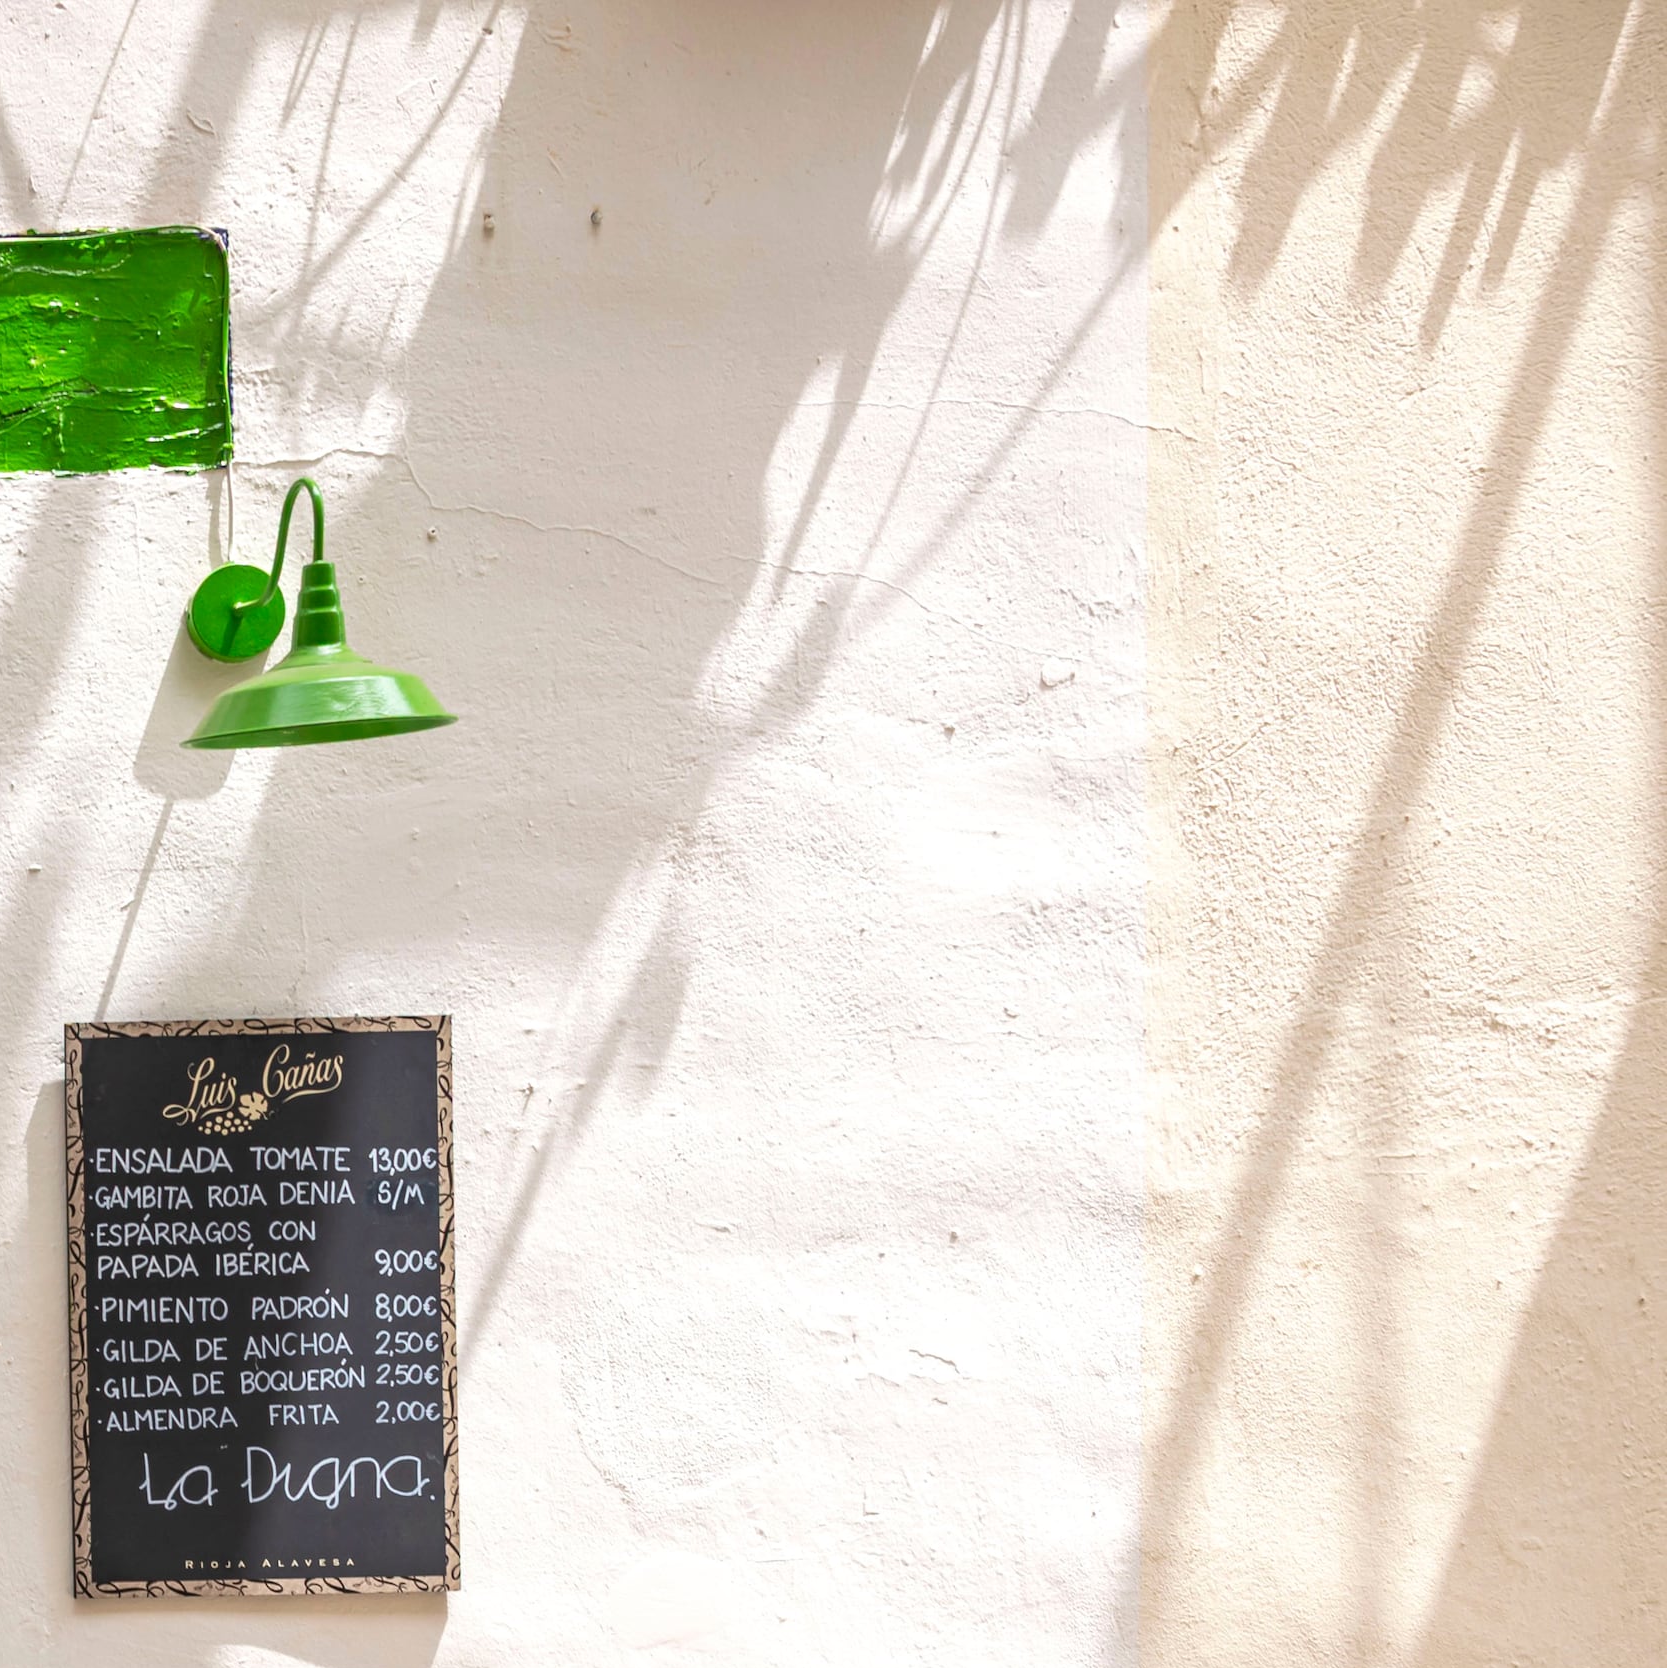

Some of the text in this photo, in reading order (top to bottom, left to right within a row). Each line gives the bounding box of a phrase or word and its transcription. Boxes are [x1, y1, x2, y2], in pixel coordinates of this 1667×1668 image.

[162, 1044, 344, 1128] Luis Cañas
[96, 1146, 437, 1177] ENSALADA TOMATE 13,00€
[94, 1178, 425, 1210] GAMBITA ROJA DENIA S/M
[96, 1213, 316, 1247] ESPÁRRAGOS CON
[97, 1242, 438, 1280] PAPADA IBÉRICA 9,00€
[101, 1287, 437, 1324] PIMIENTO PADRÓN 8,00€
[103, 1330, 439, 1363] GILDA DE ANCHOA 2,50€
[103, 1357, 440, 1400] GILDA DE BOQUERÓN 2,50€
[106, 1400, 441, 1432] ALMENDRA FRITA 2,00€
[138, 1452, 219, 1511] La
[185, 1558, 355, 1569] RIOJA ALAVESA
